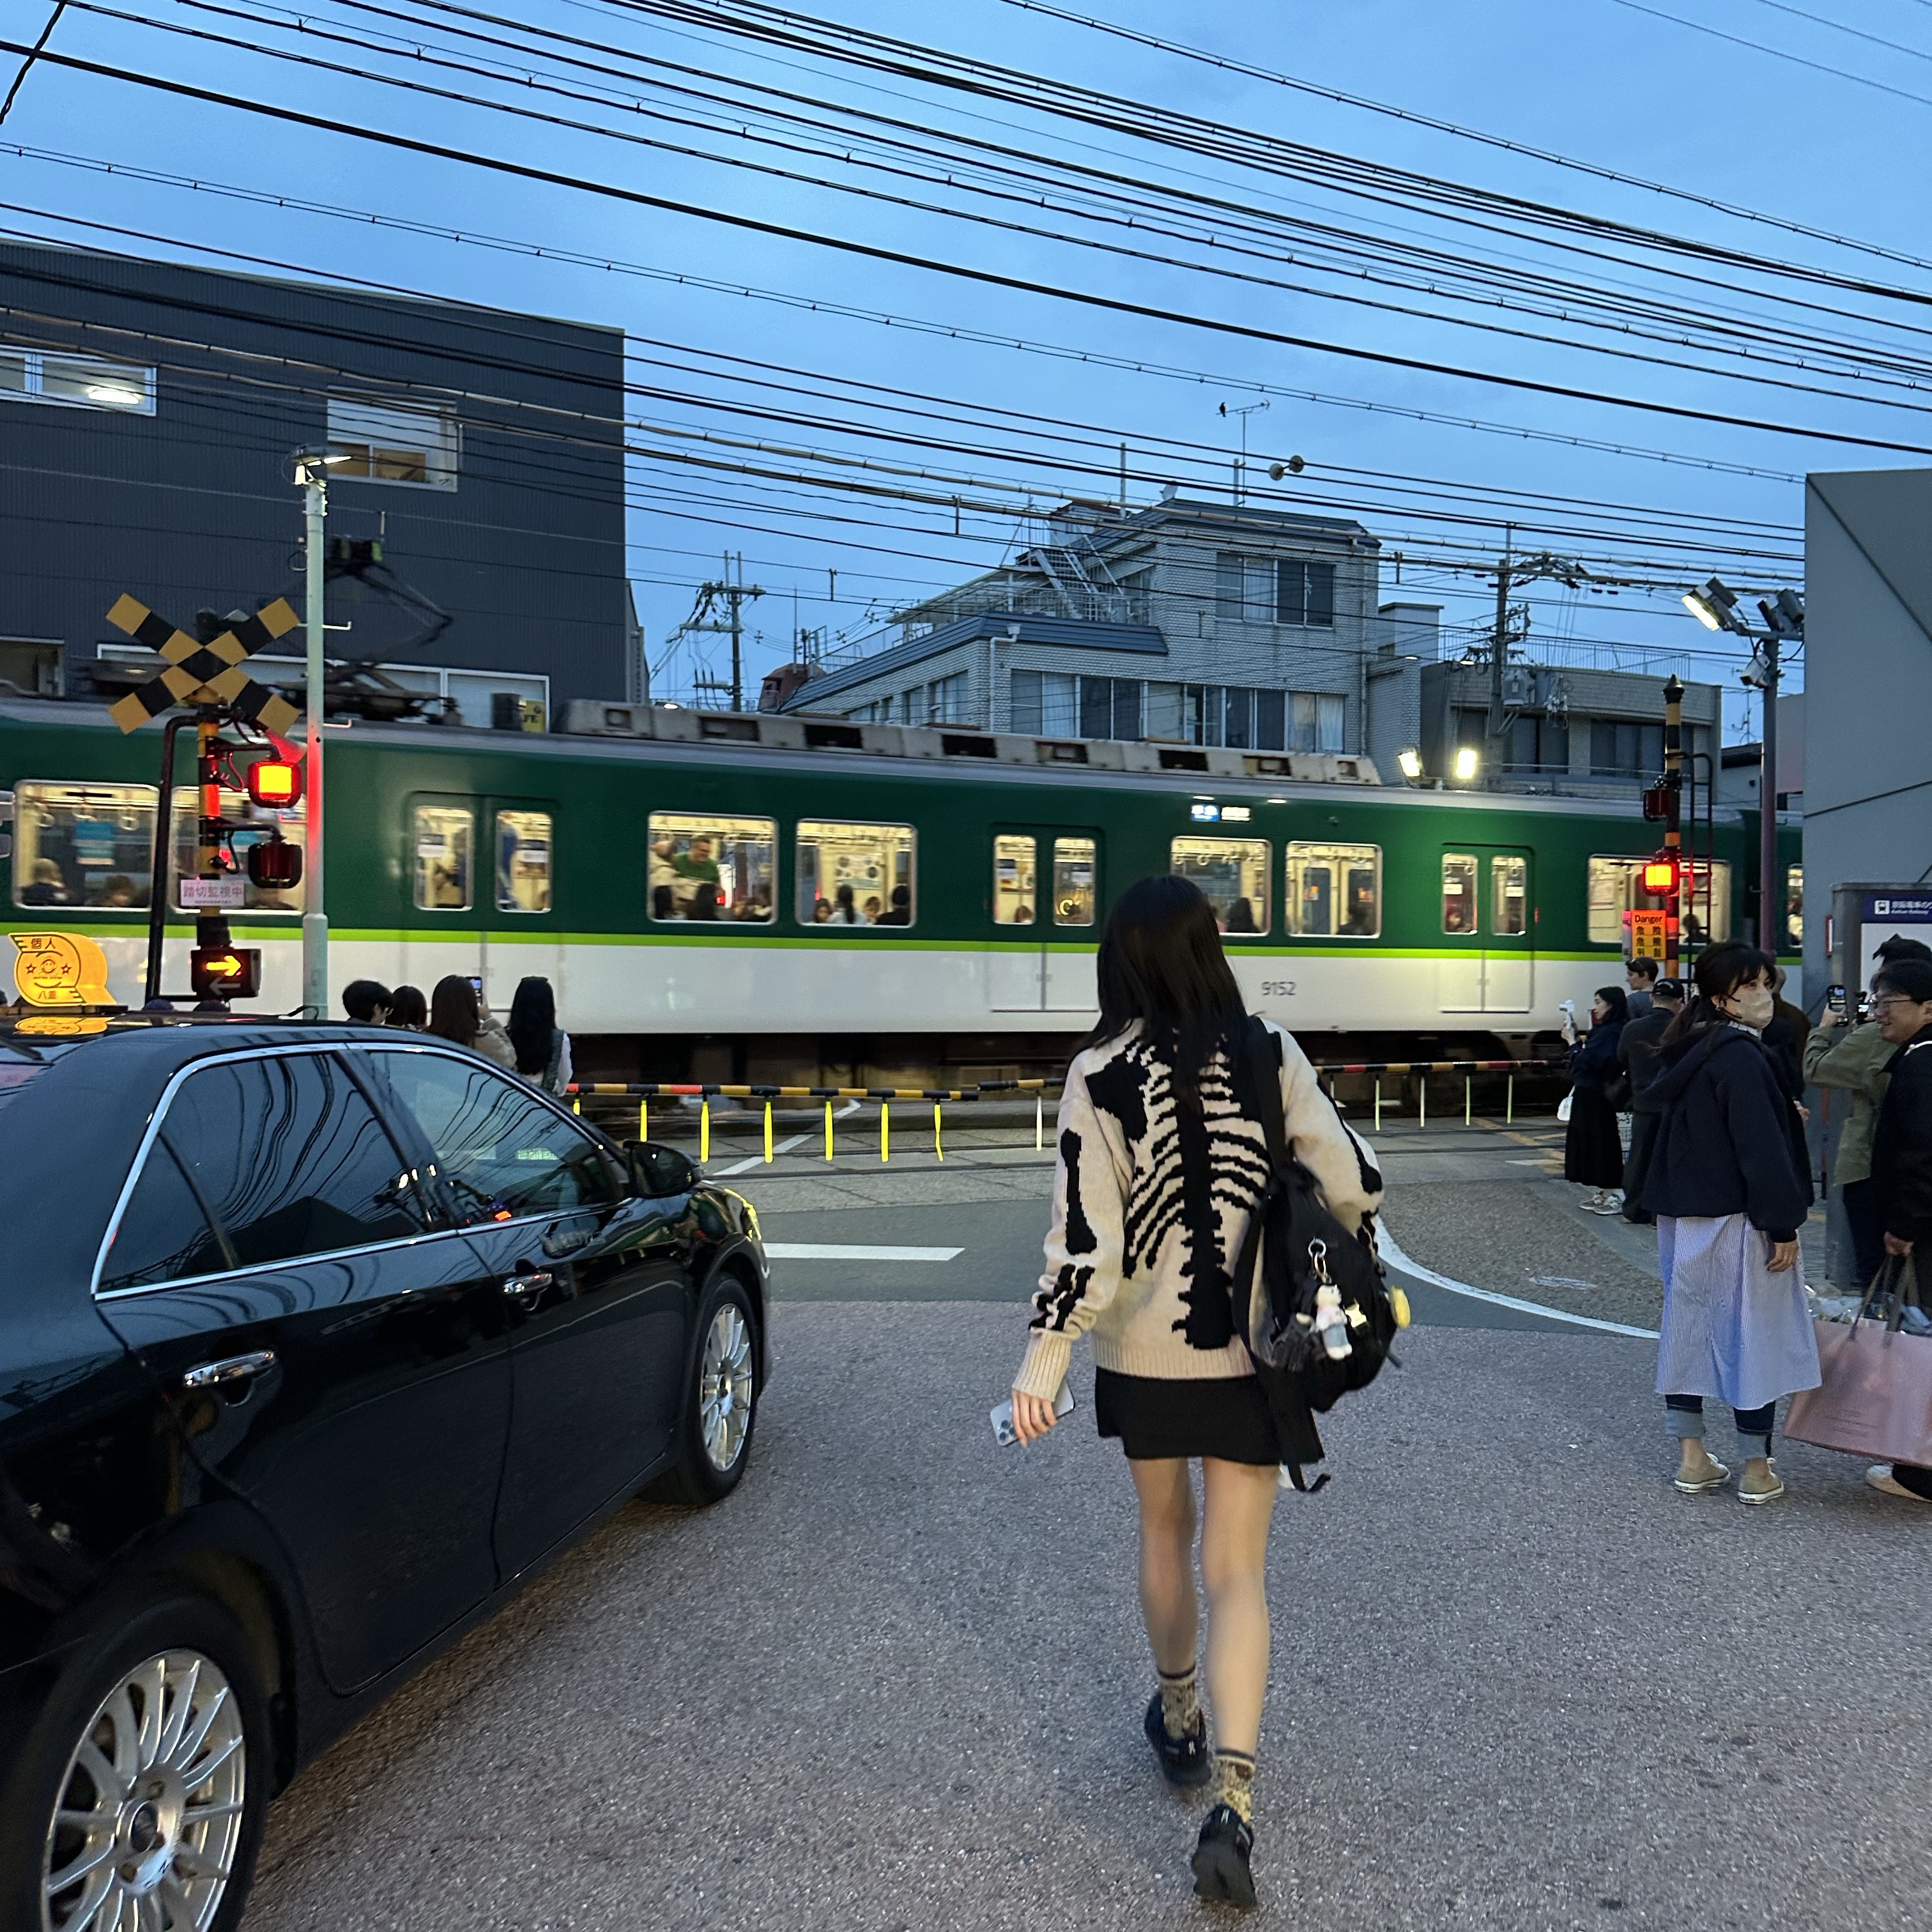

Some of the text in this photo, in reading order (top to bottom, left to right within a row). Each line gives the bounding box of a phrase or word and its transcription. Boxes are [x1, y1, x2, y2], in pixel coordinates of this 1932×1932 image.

[183, 886, 243, 898] 踏切監視中
[1635, 915, 1662, 924] Danger
[31, 937, 56, 949] 個人
[1262, 981, 1296, 995] 9152
